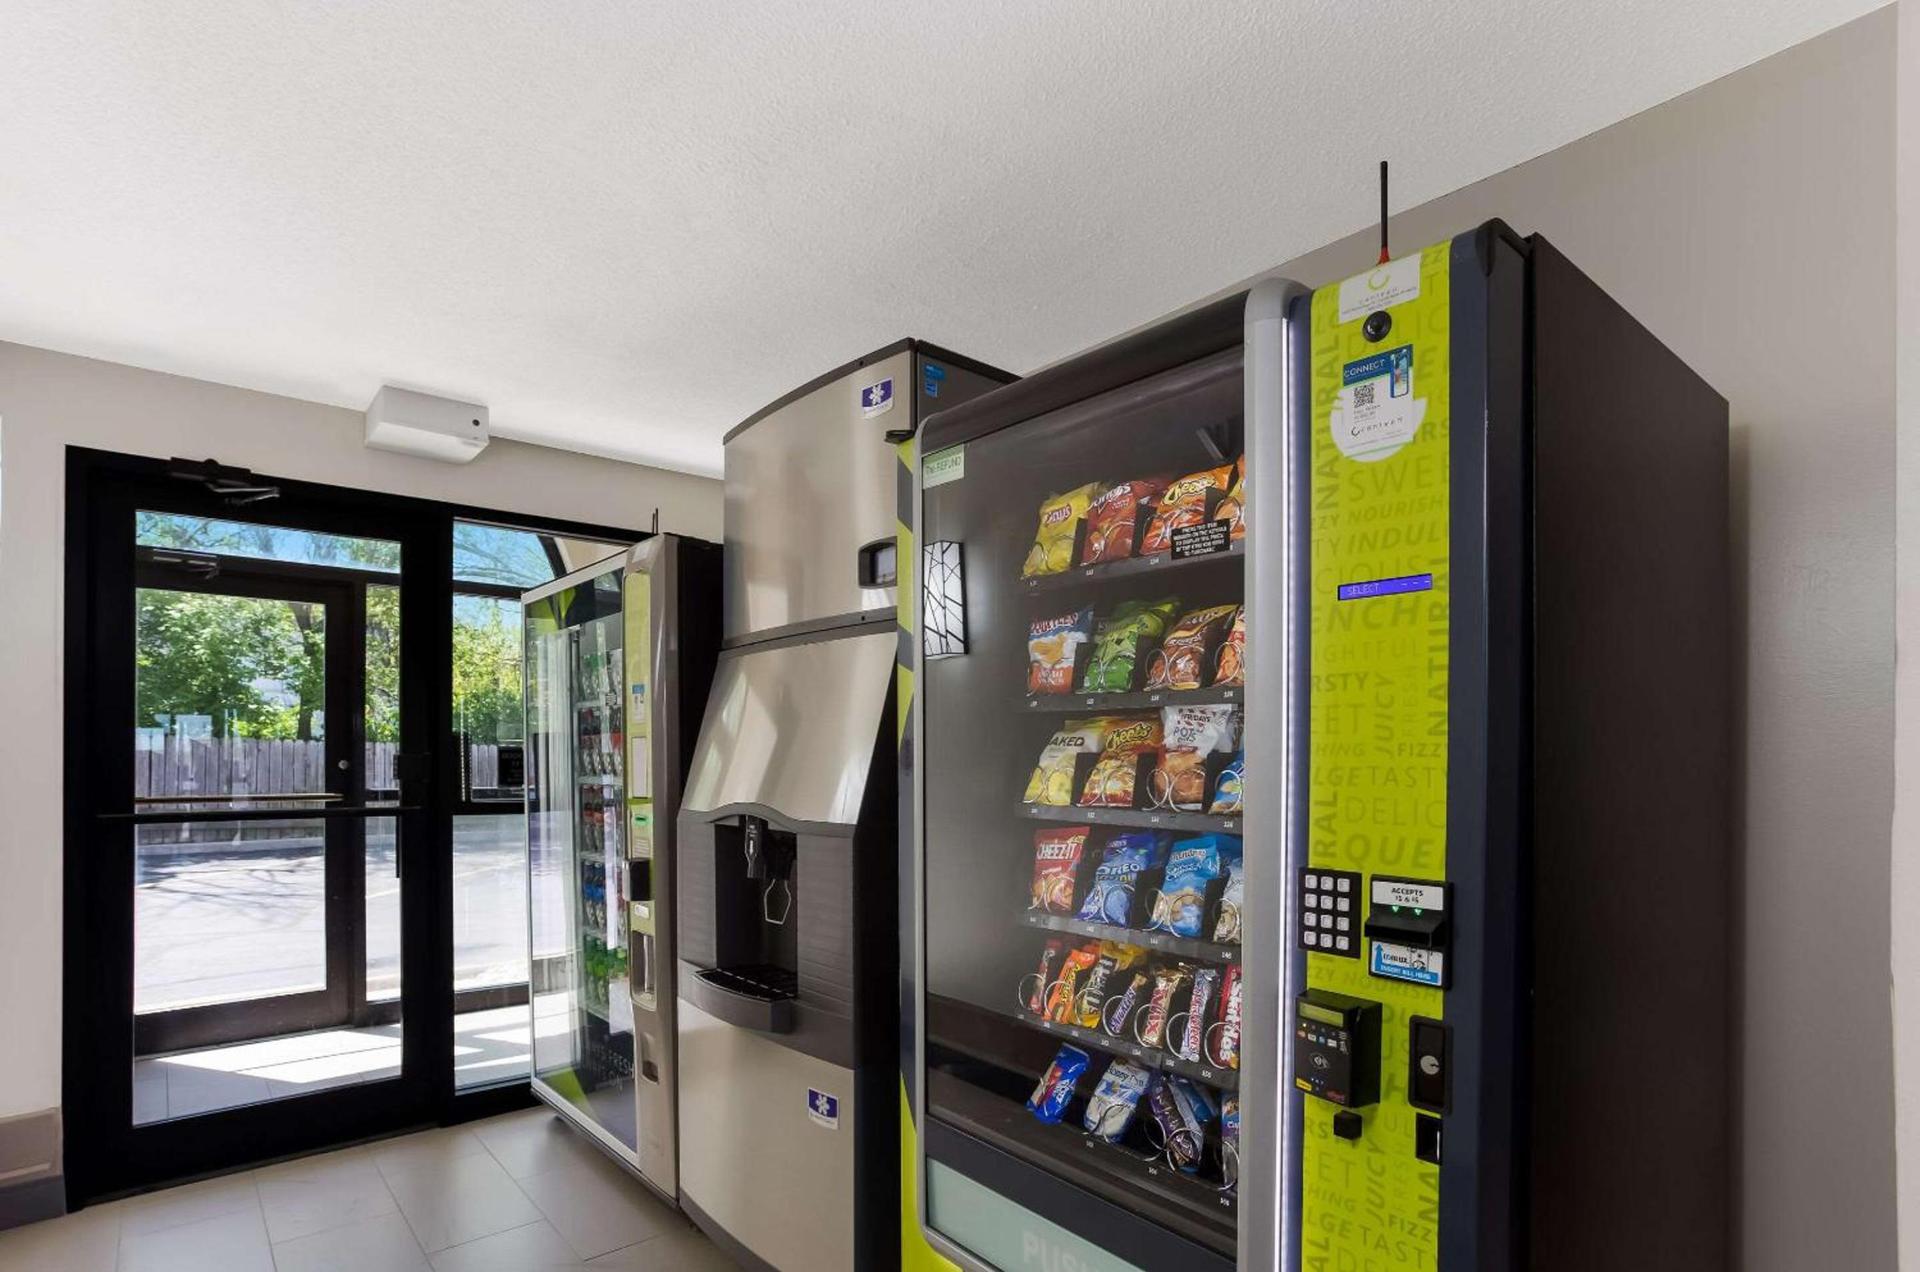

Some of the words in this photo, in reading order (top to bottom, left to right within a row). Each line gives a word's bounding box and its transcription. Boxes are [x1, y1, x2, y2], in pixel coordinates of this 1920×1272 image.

[1343, 358, 1385, 378] CONNECT
[1346, 582, 1380, 596] SELECT
[1391, 887, 1425, 898] ACCEPTS
